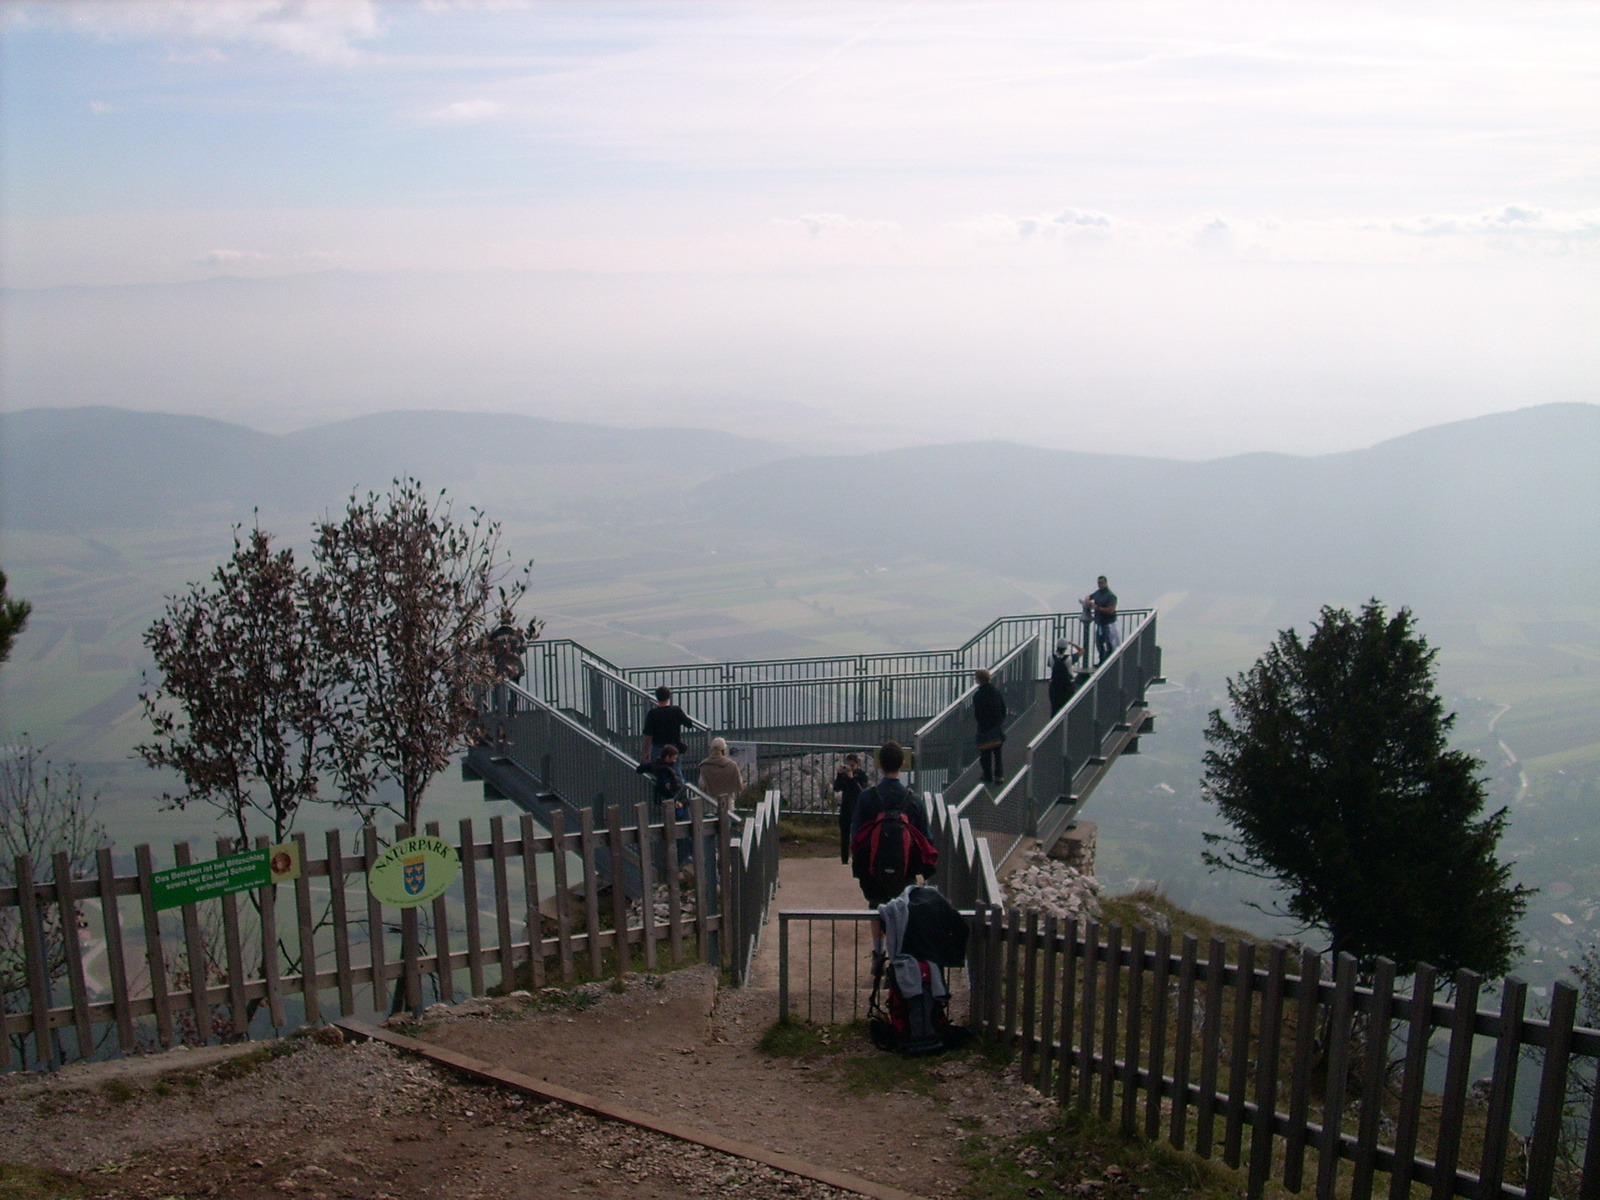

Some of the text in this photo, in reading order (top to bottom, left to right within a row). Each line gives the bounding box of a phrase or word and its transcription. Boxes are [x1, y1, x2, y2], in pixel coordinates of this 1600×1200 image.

[154, 854, 265, 884] Das Betreten ist bei Blitzschlag
[375, 839, 451, 874] NATURPARK
[166, 864, 256, 890] sowie bei Eis und Schnee
